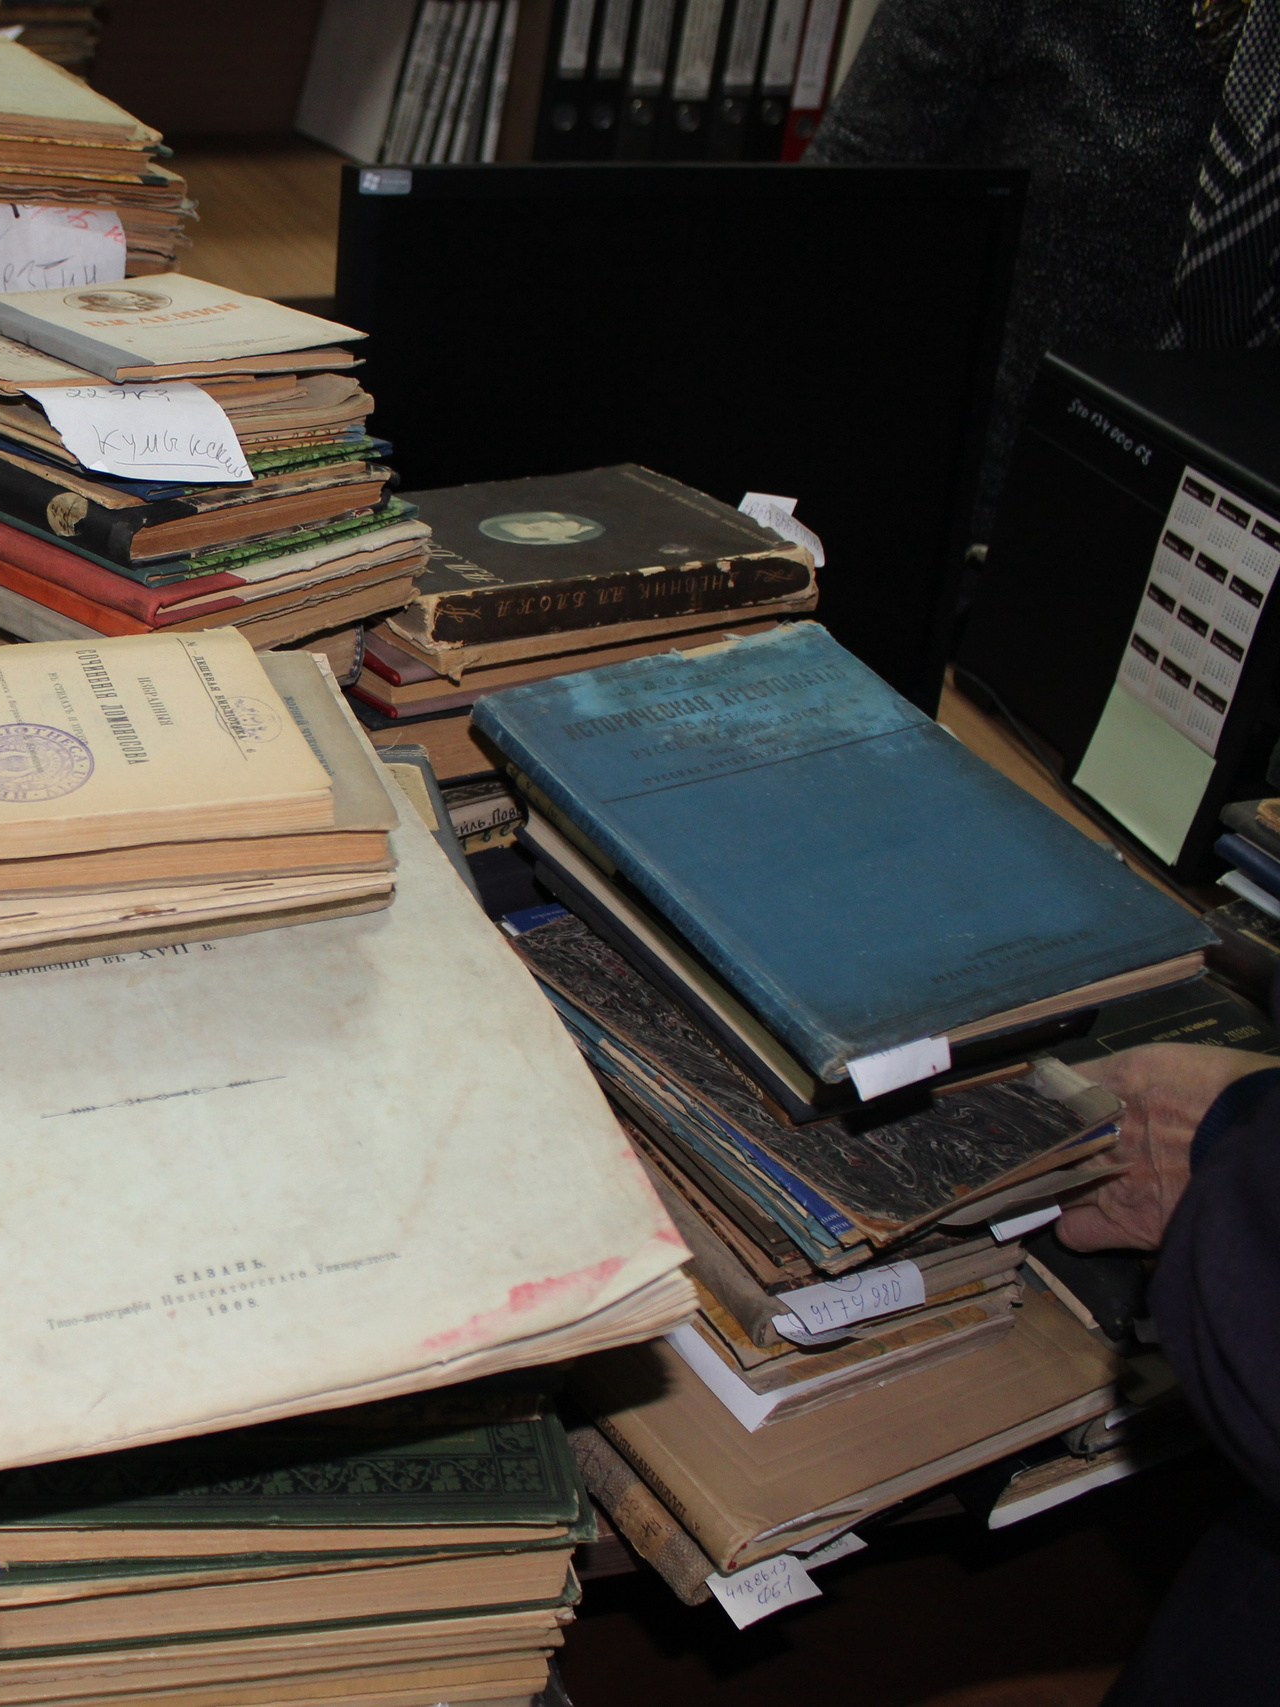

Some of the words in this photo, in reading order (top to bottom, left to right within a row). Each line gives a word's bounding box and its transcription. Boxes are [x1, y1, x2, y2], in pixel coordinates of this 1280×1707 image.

[497, 590, 588, 618] БЛОКА
[76, 650, 118, 699] СОЧИНЕНІЯ
[100, 704, 150, 765] ЛОМОНОСОВА
[562, 694, 713, 741] ИСТОРИЧЕСКАЯ
